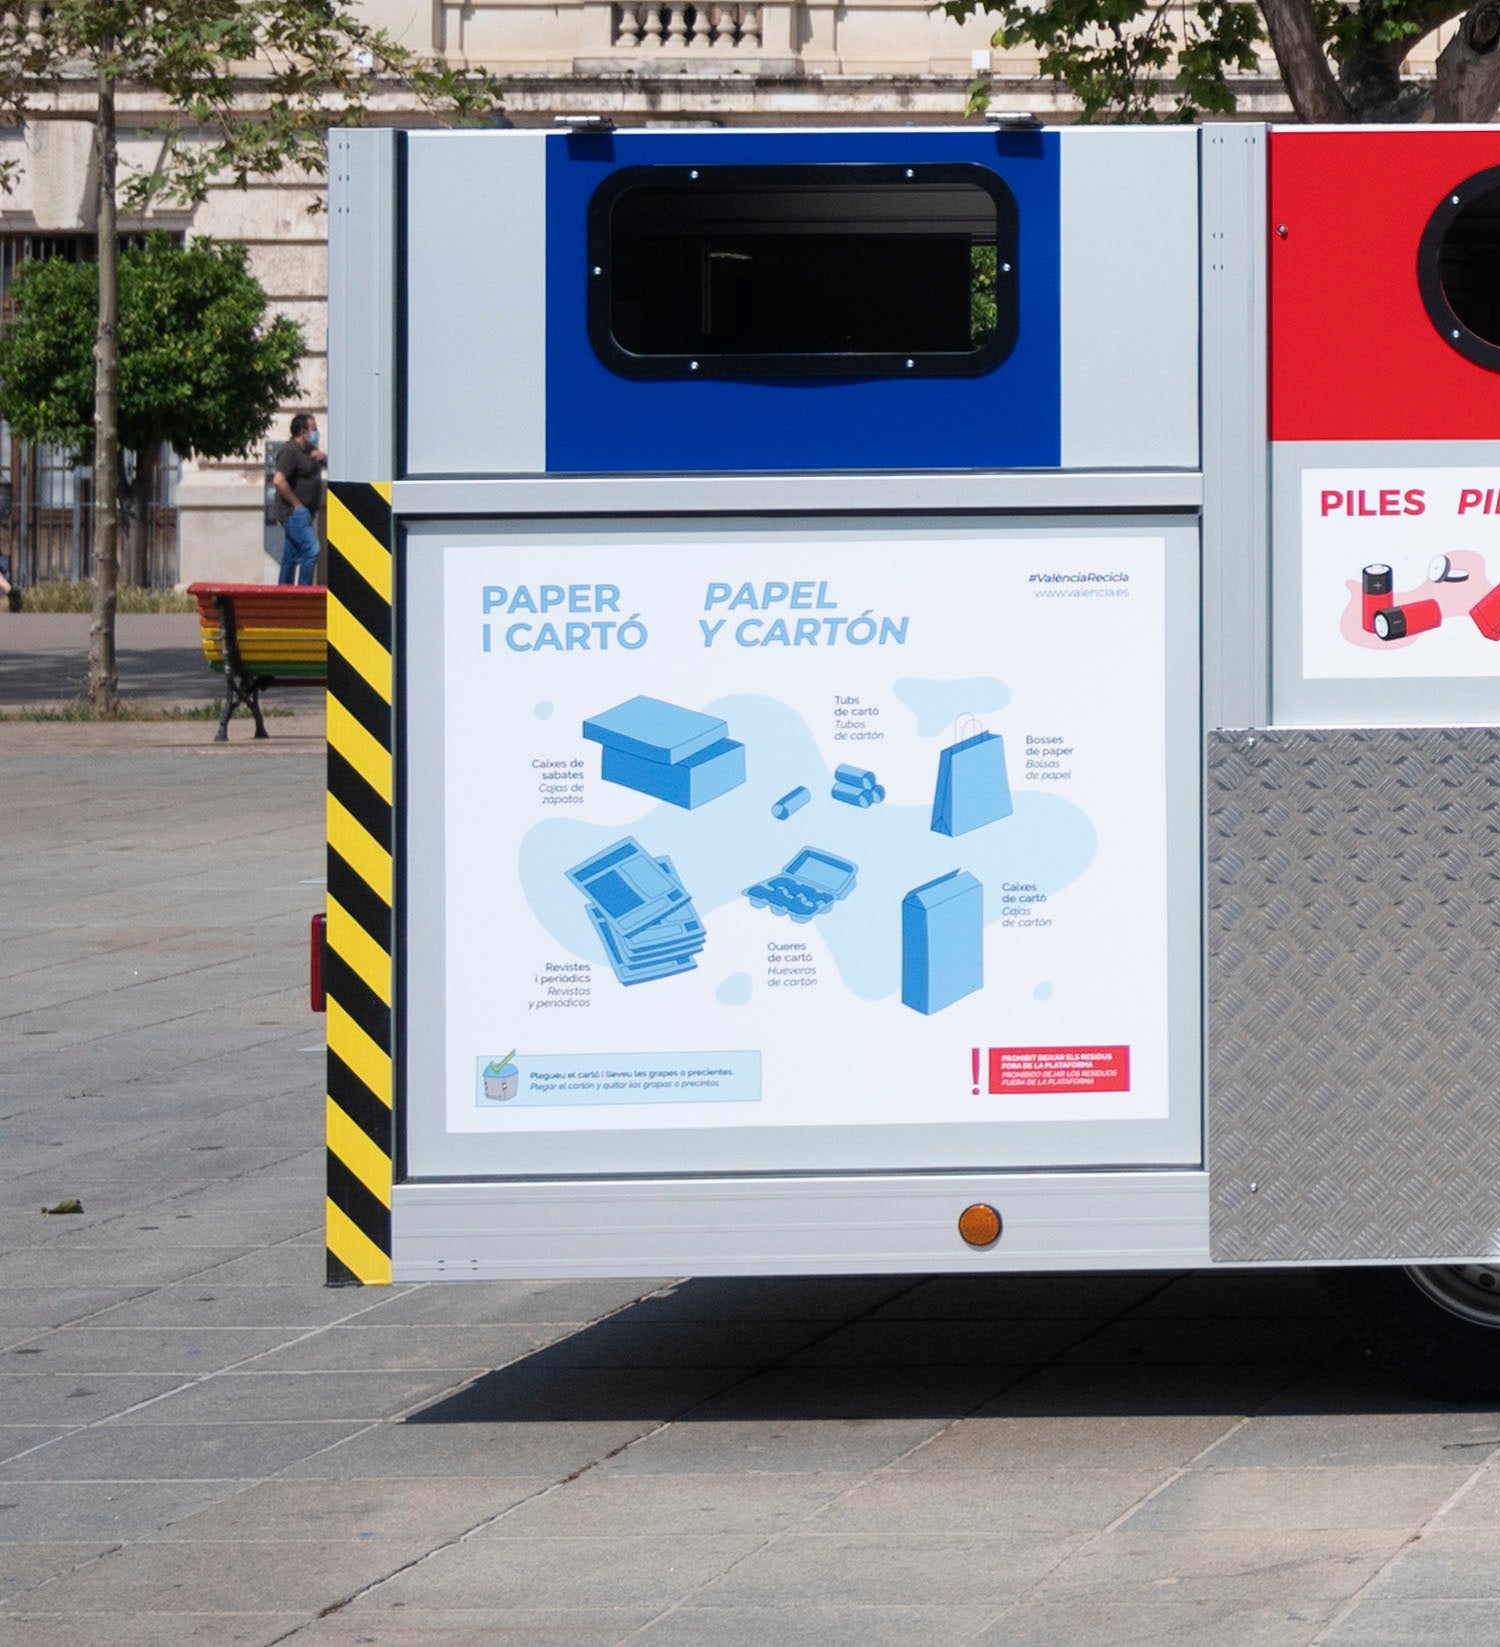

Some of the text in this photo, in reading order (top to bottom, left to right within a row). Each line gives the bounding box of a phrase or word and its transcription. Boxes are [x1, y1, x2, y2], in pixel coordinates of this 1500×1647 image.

[1322, 489, 1425, 516] PILES
[1029, 572, 1129, 583] #ValènciaRecicla
[483, 584, 620, 614] PAPER
[704, 581, 837, 610] PAPEL
[483, 612, 648, 652] I CARTÓ
[699, 609, 909, 647] Y CARTÓN
[835, 696, 860, 705] Tubs
[834, 708, 879, 716] de cartó
[836, 720, 865, 729] Tubos
[834, 731, 884, 740] de cartón
[1026, 735, 1064, 744] Bosses
[1026, 747, 1074, 757] de paper
[532, 759, 584, 768] Caixes de
[1026, 759, 1060, 768] Bolsas
[542, 771, 584, 780] sabates
[1026, 771, 1071, 781] de papel
[538, 783, 584, 794] Cajas de
[542, 795, 584, 805] zapatos
[1002, 882, 1037, 891] Caixes
[1002, 894, 1047, 903] de cartó
[1002, 906, 1031, 917] Cajas
[1002, 917, 1052, 927] de cartón
[768, 942, 806, 951] Oueres
[768, 953, 812, 962] de cartó
[546, 963, 591, 971] Revistes
[768, 967, 816, 975] Hueveras
[768, 977, 817, 987] de cartón
[547, 986, 590, 996] Revistas
[536, 998, 590, 1010] periódicos
